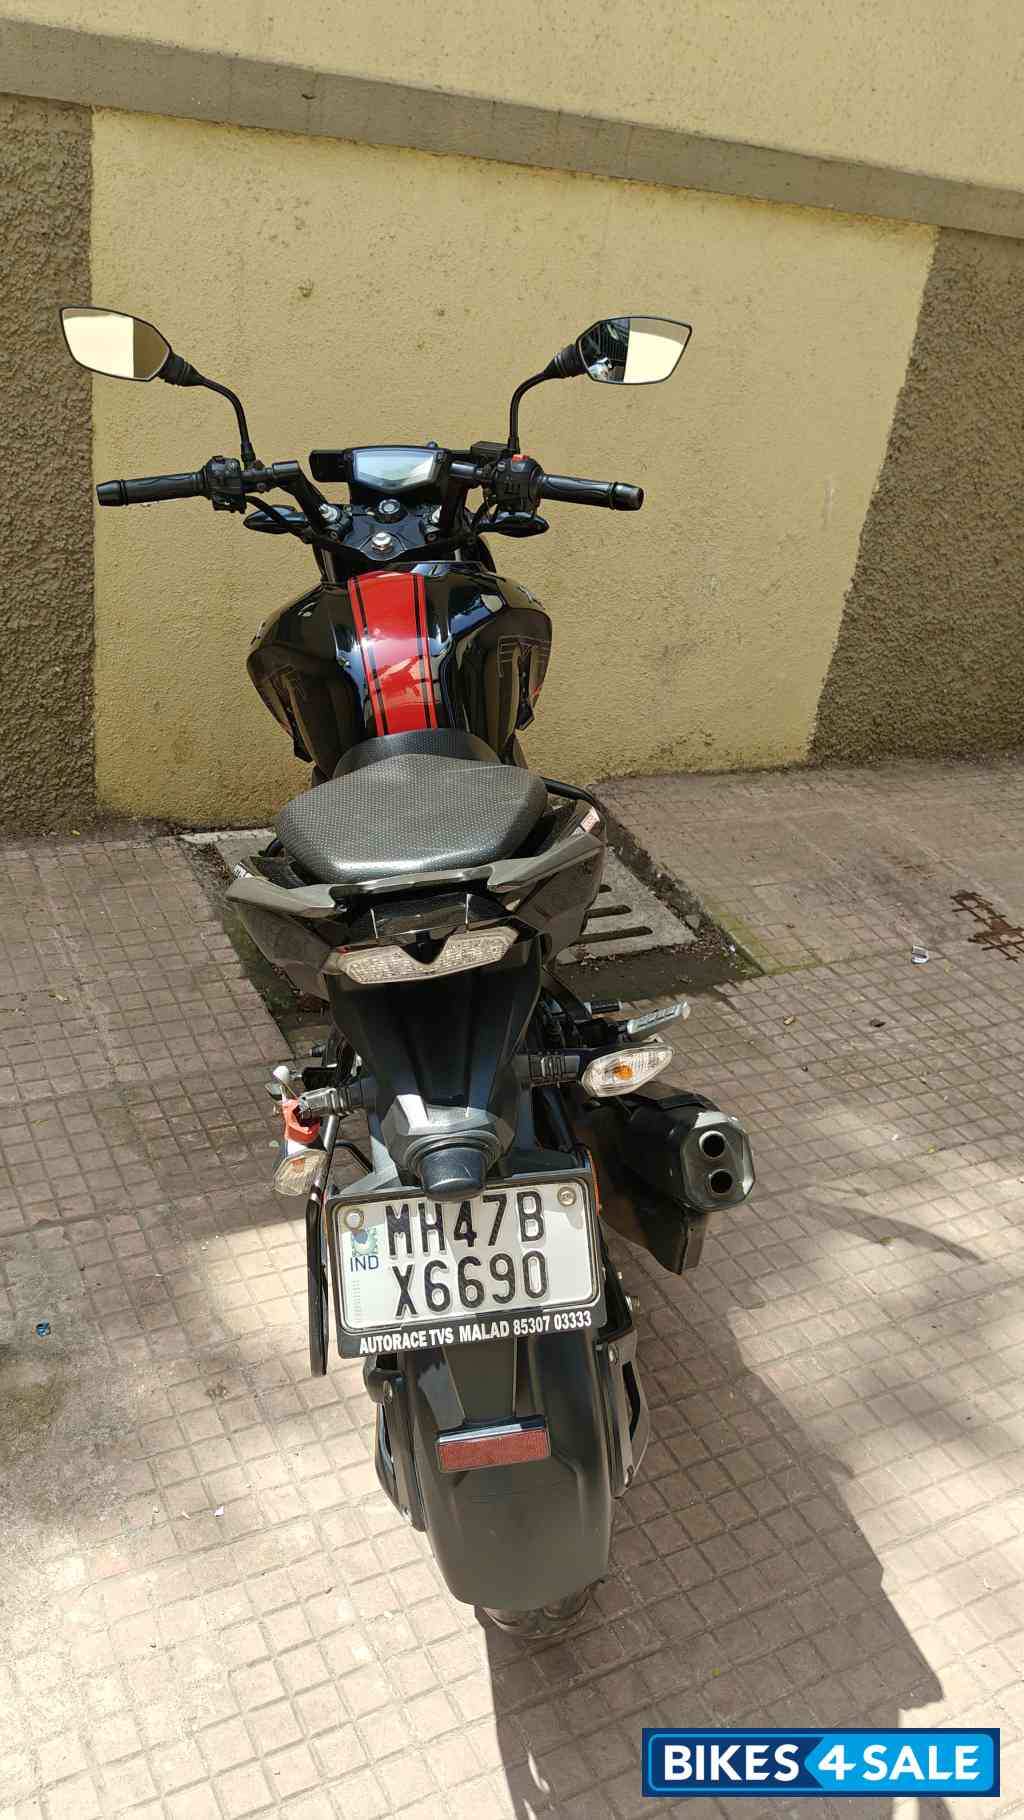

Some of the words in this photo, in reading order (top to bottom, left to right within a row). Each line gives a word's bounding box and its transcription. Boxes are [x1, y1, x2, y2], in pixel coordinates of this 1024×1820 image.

[384, 1189, 545, 1257] MH47B
[350, 1254, 379, 1272] IND
[391, 1250, 548, 1318] X6690
[359, 1329, 427, 1355] AUTORACE
[428, 1327, 454, 1347] TVS
[459, 1319, 510, 1344] MALAD
[513, 1315, 550, 1336] 85307
[553, 1310, 592, 1330] 03333
